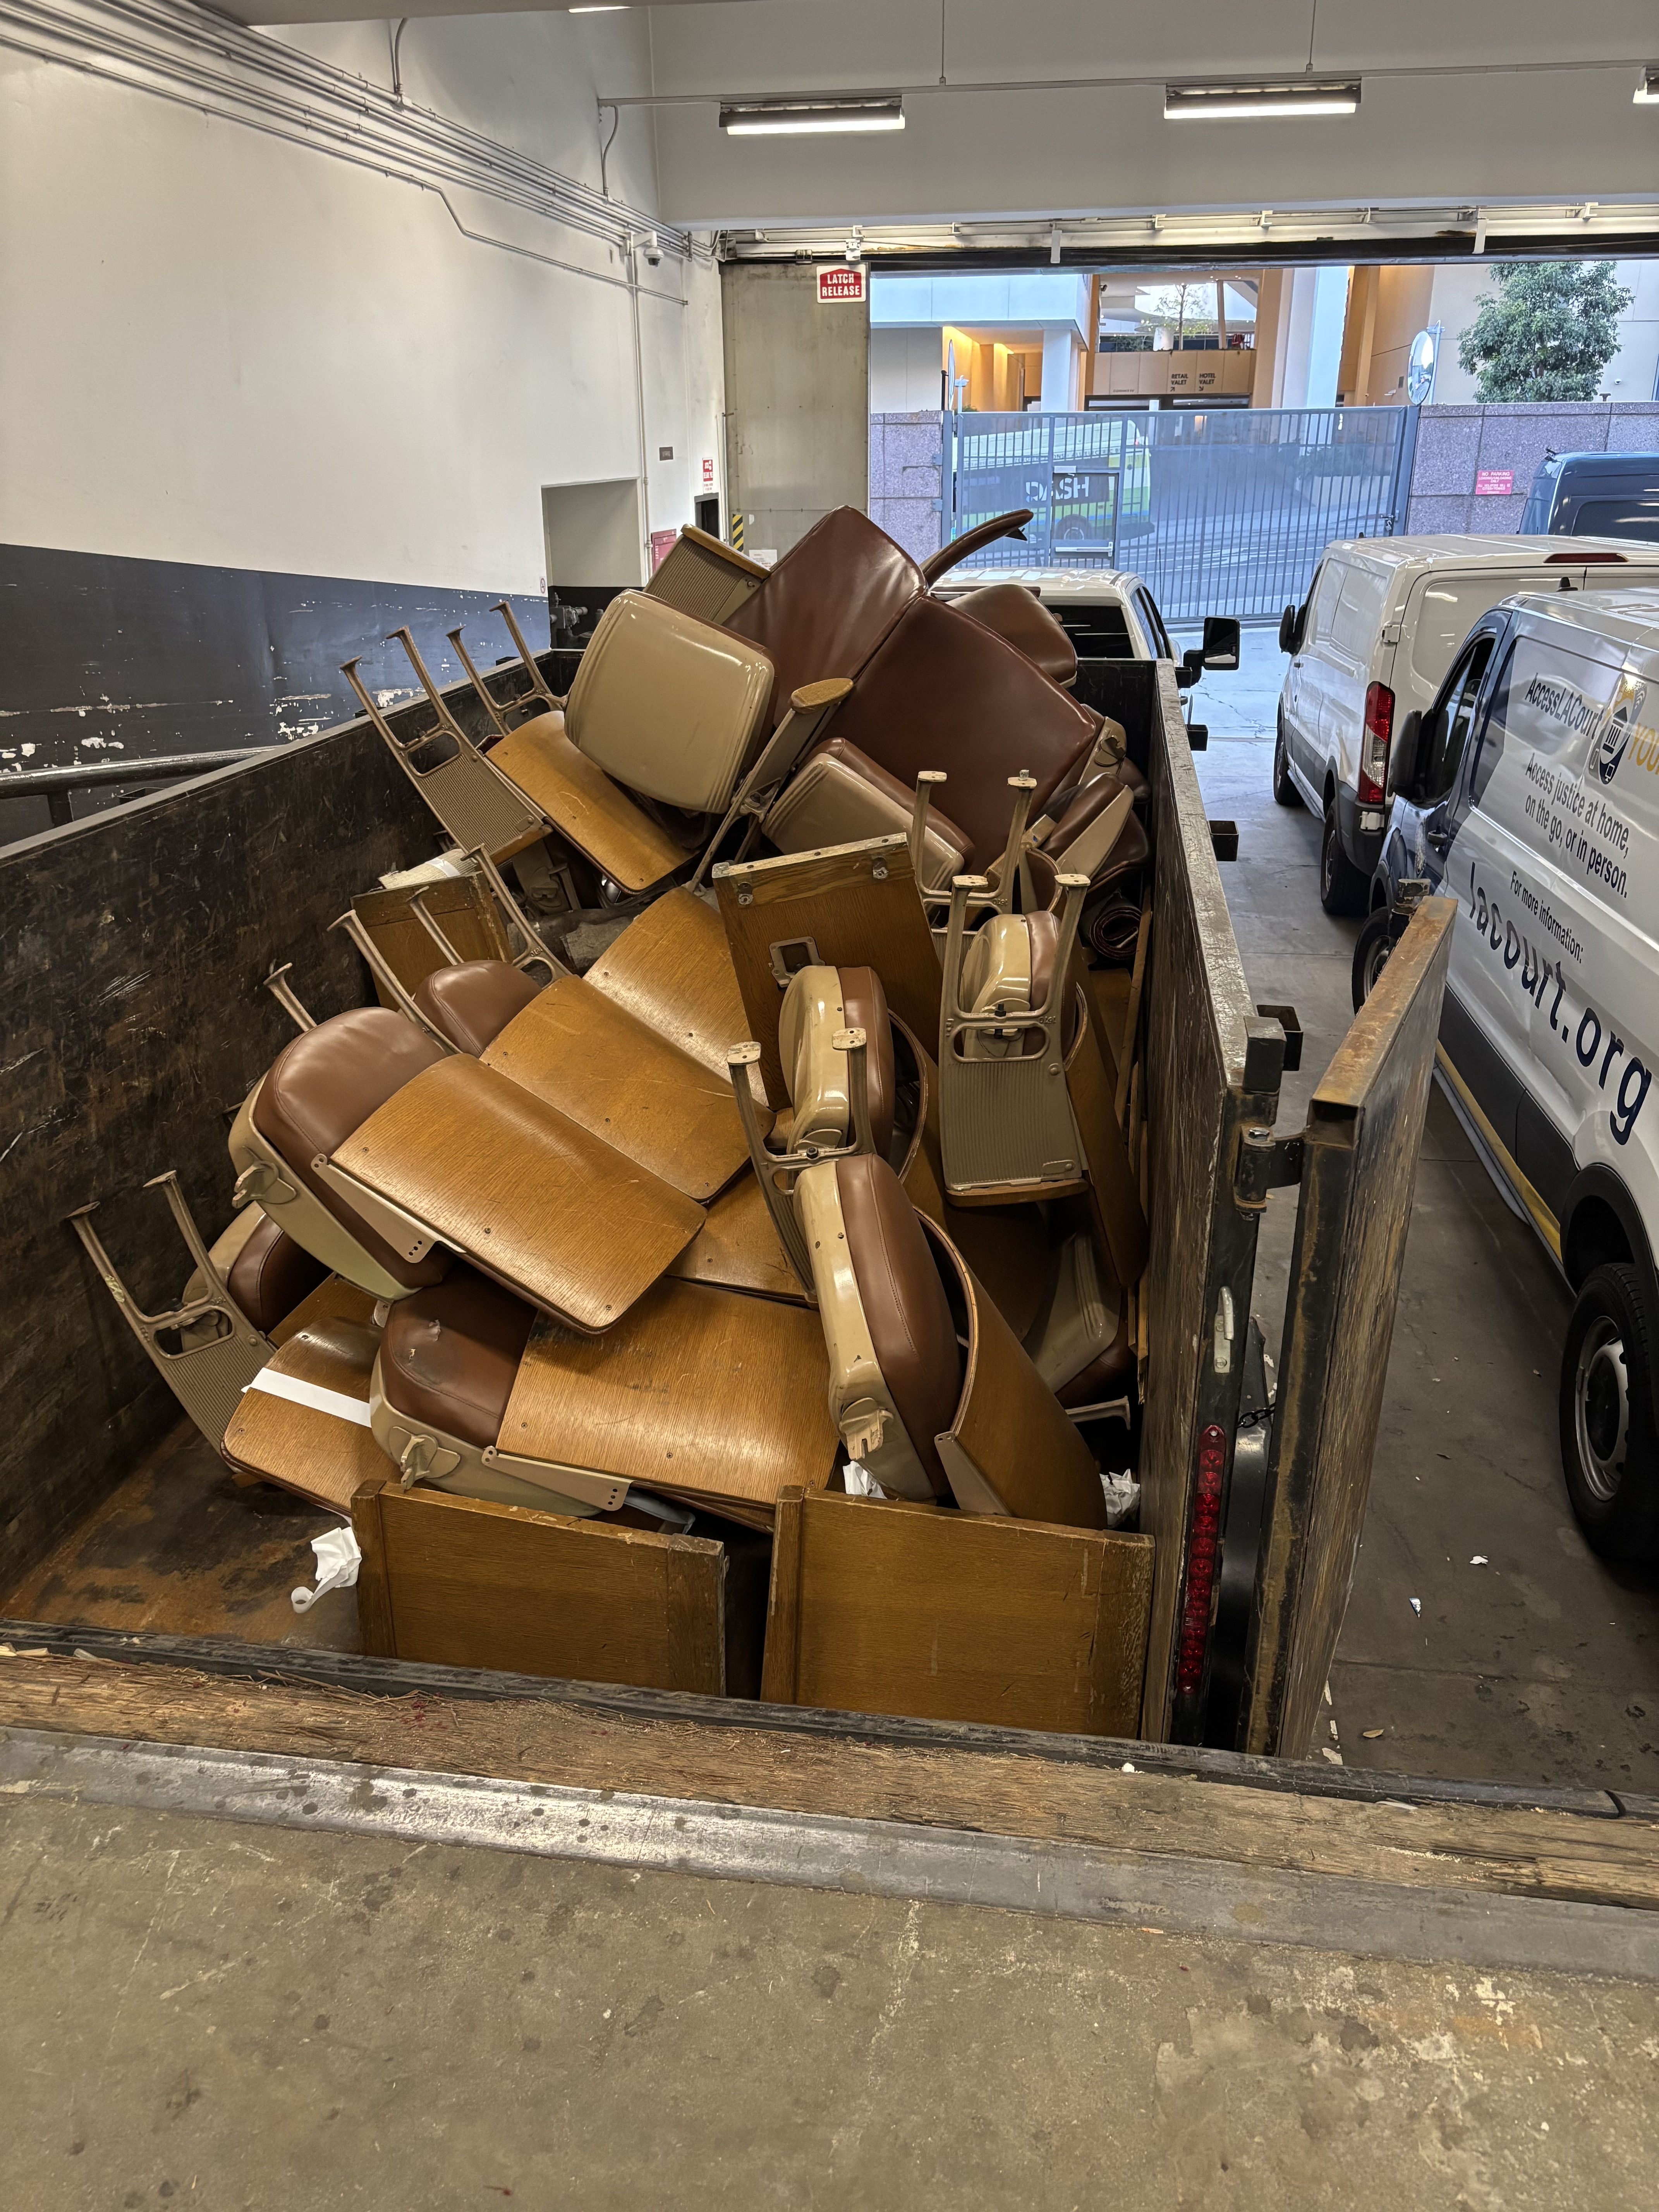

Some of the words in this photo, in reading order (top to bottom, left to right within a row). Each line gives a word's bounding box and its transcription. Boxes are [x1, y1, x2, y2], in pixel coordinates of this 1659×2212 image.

[822, 285, 860, 296] RELEASE
[827, 273, 854, 284] LATCH
[1025, 476, 1089, 503] DASH
[1525, 672, 1604, 740] AccessLACourt
[1628, 722, 1659, 775] YOU
[1525, 752, 1554, 794] Access
[1551, 772, 1585, 817] justice
[1585, 800, 1599, 828] at
[1596, 803, 1629, 859] home,
[1525, 795, 1535, 818] on
[1536, 799, 1549, 830] the
[1549, 816, 1563, 848] go,
[1565, 828, 1577, 852] or
[1577, 830, 1588, 862] in
[1586, 847, 1627, 898] person.
[1510, 871, 1522, 897] For
[1522, 887, 1538, 915] more
[1539, 900, 1583, 963] information:
[1469, 862, 1652, 1146] lacourt.org
